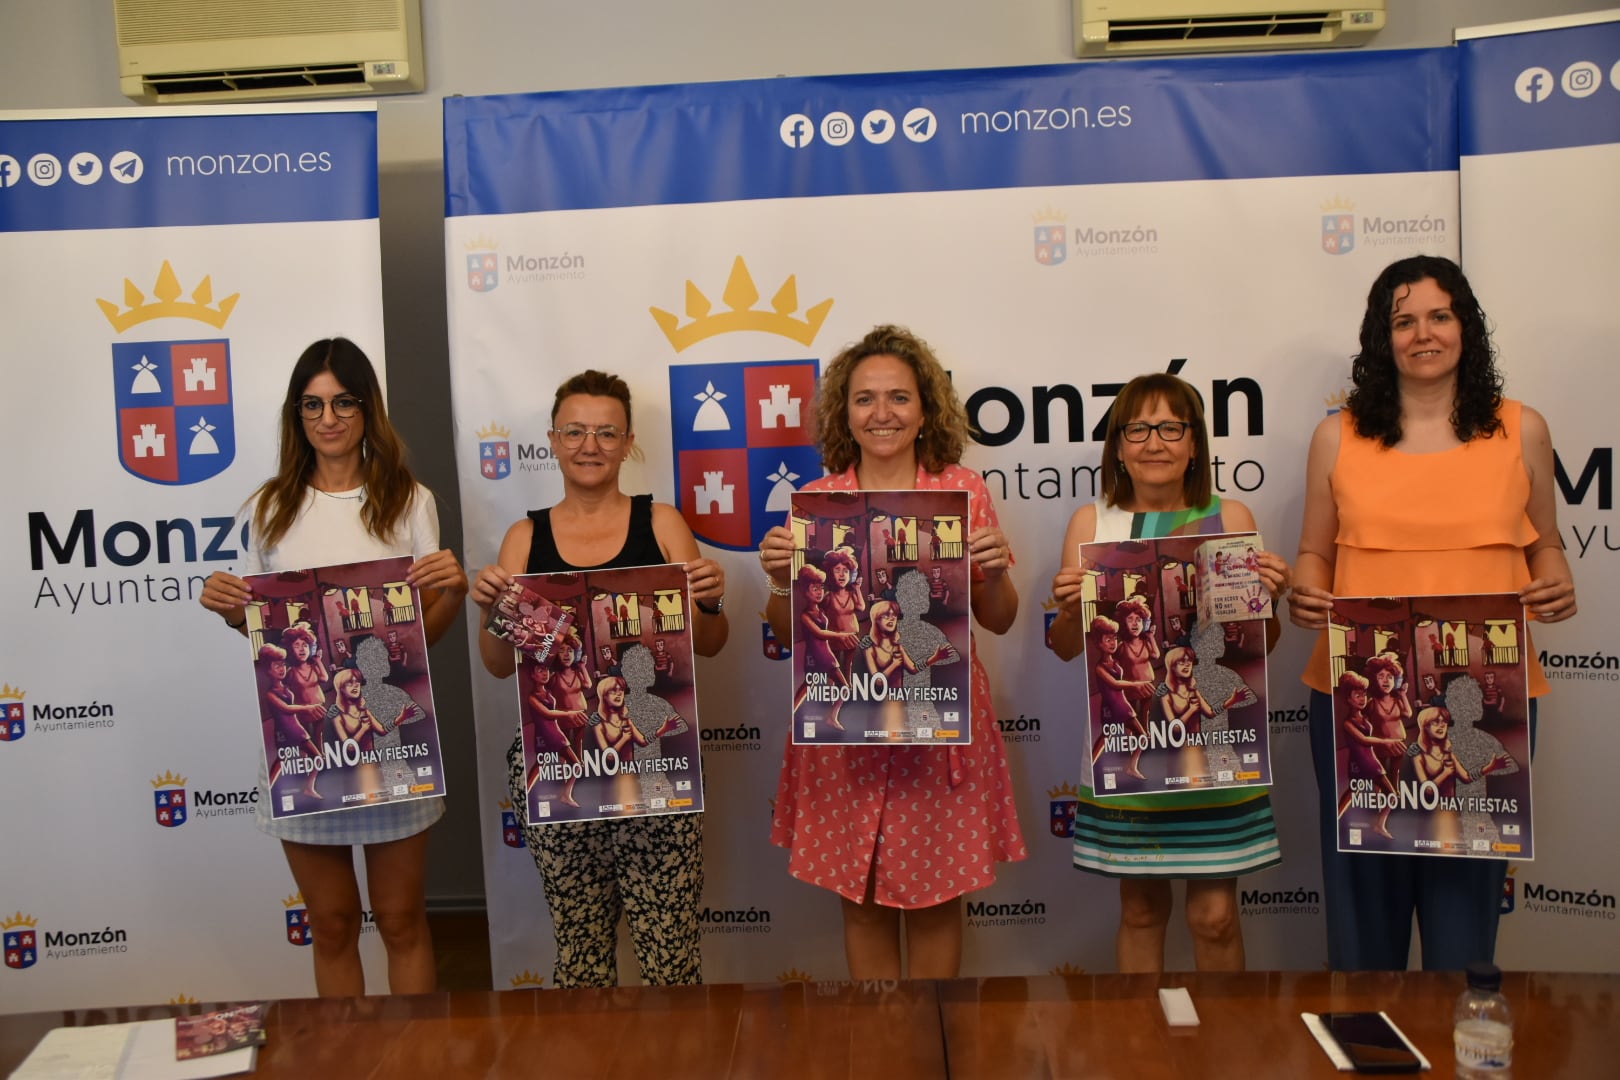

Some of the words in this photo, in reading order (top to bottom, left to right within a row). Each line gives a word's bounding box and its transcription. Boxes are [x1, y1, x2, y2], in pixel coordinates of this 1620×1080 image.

[961, 105, 1132, 134] monzon.es
[167, 151, 332, 176] monzon.es
[1363, 214, 1446, 235] Monzón
[1075, 225, 1158, 245] Monzón
[1364, 234, 1446, 247] Ayuntamiento
[1076, 245, 1159, 258] Ayuntamiento
[506, 251, 585, 272] Monzón
[507, 270, 585, 285] Ayuntamiento
[805, 672, 827, 685] CON
[1544, 670, 1619, 681] untamiento
[806, 685, 850, 702] MIEDO
[852, 671, 888, 702] NO
[888, 687, 911, 701] HAY
[914, 687, 958, 701] FIESTAS
[32, 701, 114, 721] Monzón
[34, 719, 115, 733] Ayuntamiento
[700, 723, 761, 741] onzón
[1102, 722, 1125, 736] CON
[1104, 734, 1149, 753] MIEDO
[1149, 718, 1186, 749] NO
[1186, 731, 1209, 747] HAY
[1212, 728, 1257, 745] FIESTAS
[277, 745, 300, 760] CON
[280, 755, 324, 776] MIEDO
[323, 738, 360, 770] NO
[361, 750, 383, 764] HAY
[385, 742, 429, 761] FIESTAS
[536, 751, 559, 765] CON
[538, 762, 582, 782] MIEDO
[583, 746, 620, 778] NO
[620, 759, 643, 775] HAY
[645, 756, 689, 773] FIESTAS
[1349, 778, 1373, 791] CON
[194, 787, 259, 807] Monzó
[1351, 792, 1398, 809] MIEDO
[1400, 780, 1440, 811] NO
[1440, 796, 1465, 811] HAY
[1468, 797, 1518, 814] FIESTAS
[195, 806, 256, 819] Ayuntamie
[1241, 887, 1319, 906] Monzón
[1524, 882, 1616, 909] Monzón
[966, 899, 1046, 917] Monzón
[1241, 905, 1320, 917] Ayuntamiento
[1524, 901, 1616, 920] Ayuntamiento
[700, 924, 771, 935] yuntamiento
[967, 916, 1046, 928] Ayuntamiento
[45, 926, 127, 948] Monzón
[46, 944, 128, 959] Ayuntamiento
